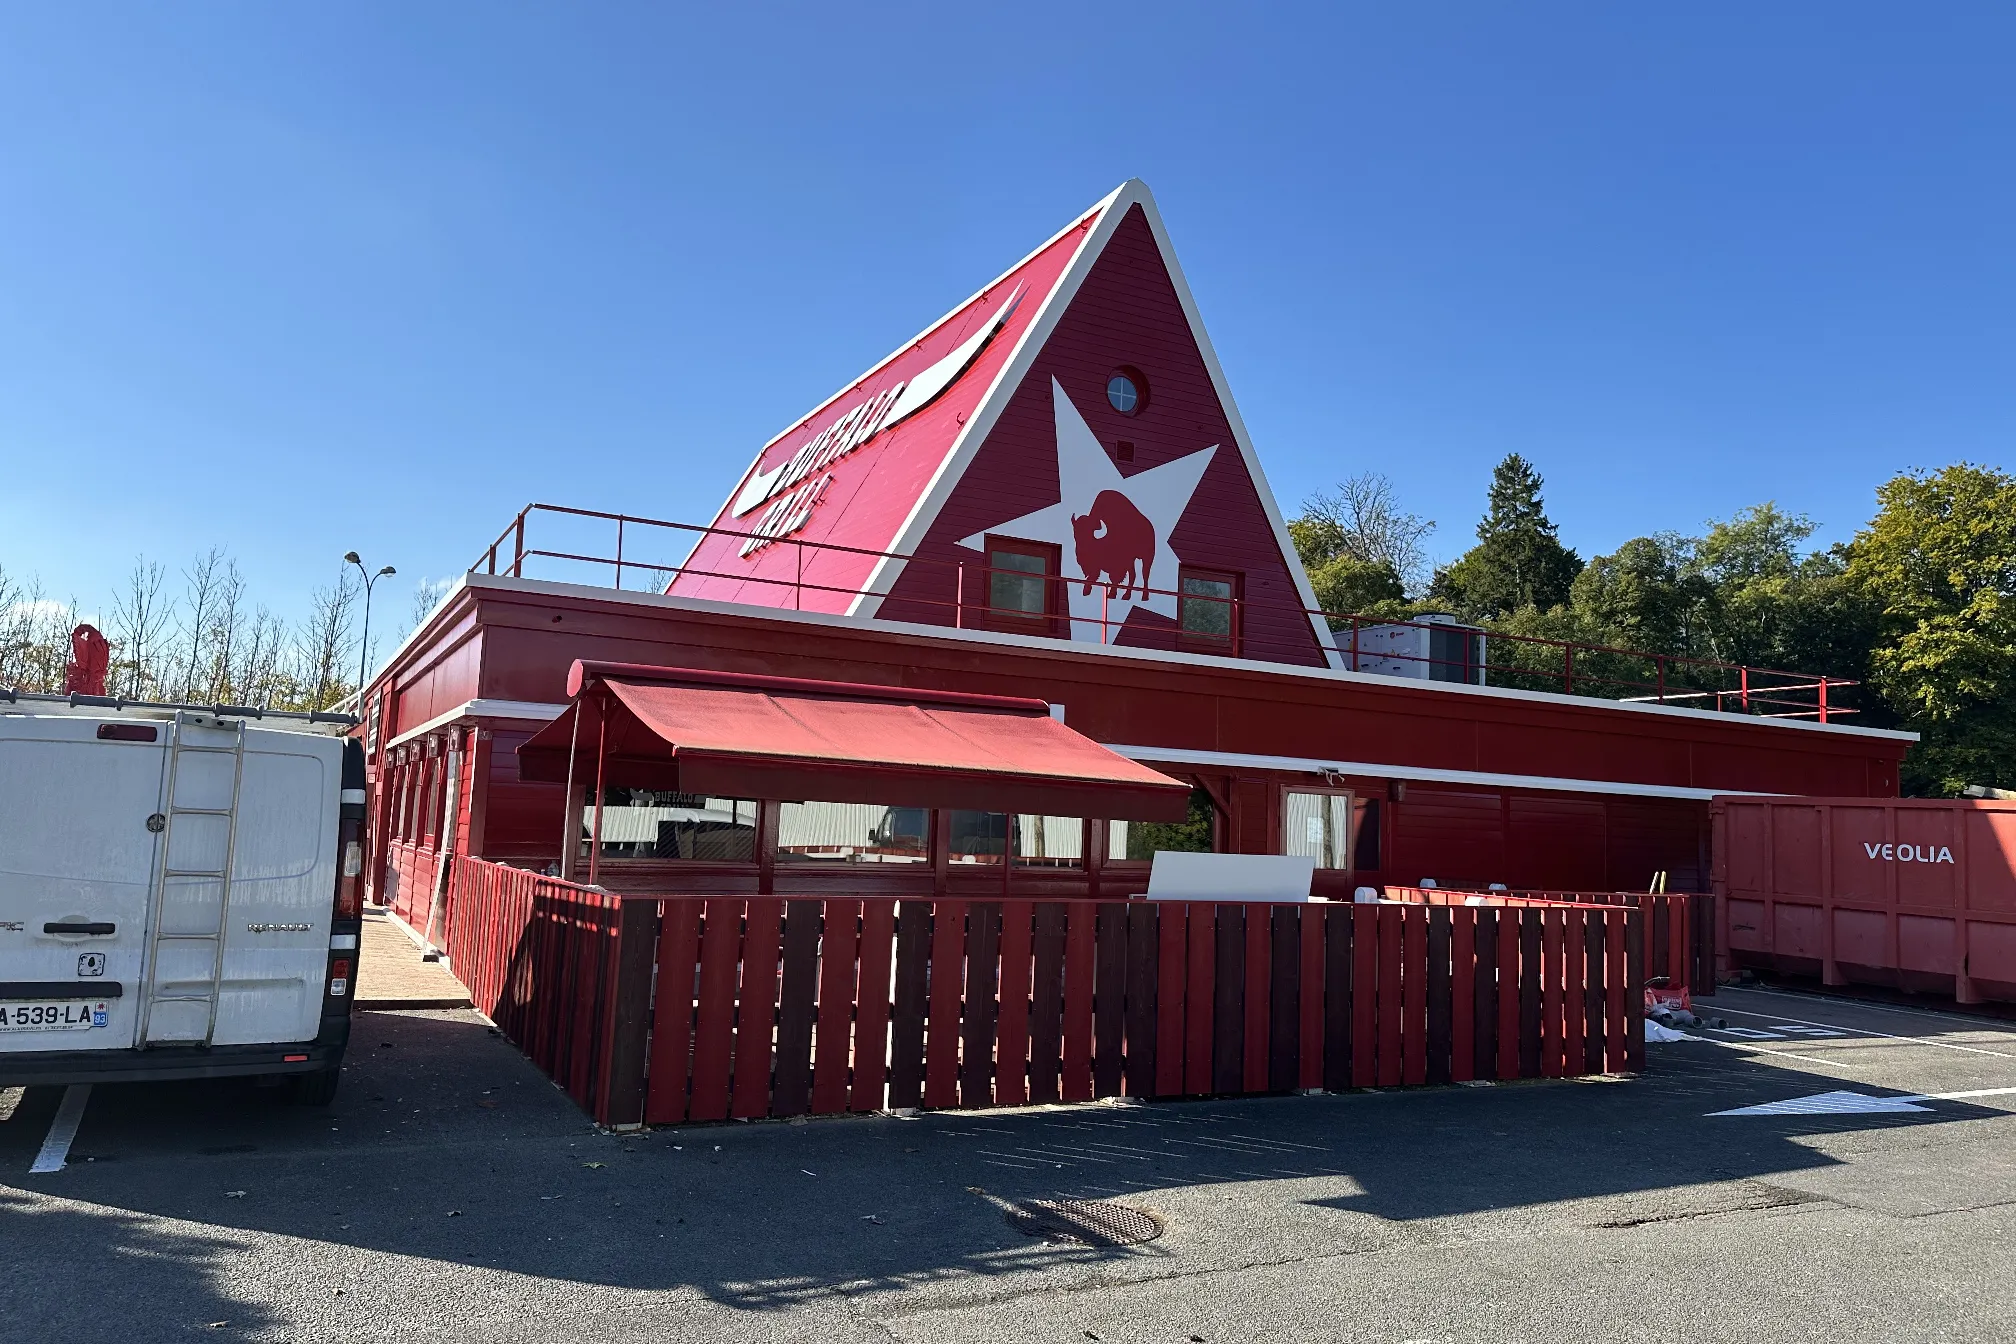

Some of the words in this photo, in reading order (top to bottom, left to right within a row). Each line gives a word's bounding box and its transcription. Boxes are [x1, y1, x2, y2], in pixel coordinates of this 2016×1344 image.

[768, 381, 905, 498] BUFFALO
[738, 471, 832, 557] GRILL
[655, 791, 693, 802] BUFFALO
[1863, 842, 1955, 864] VEOLIA
[247, 923, 314, 933] RENAULT
[94, 1014, 106, 1024] 93
